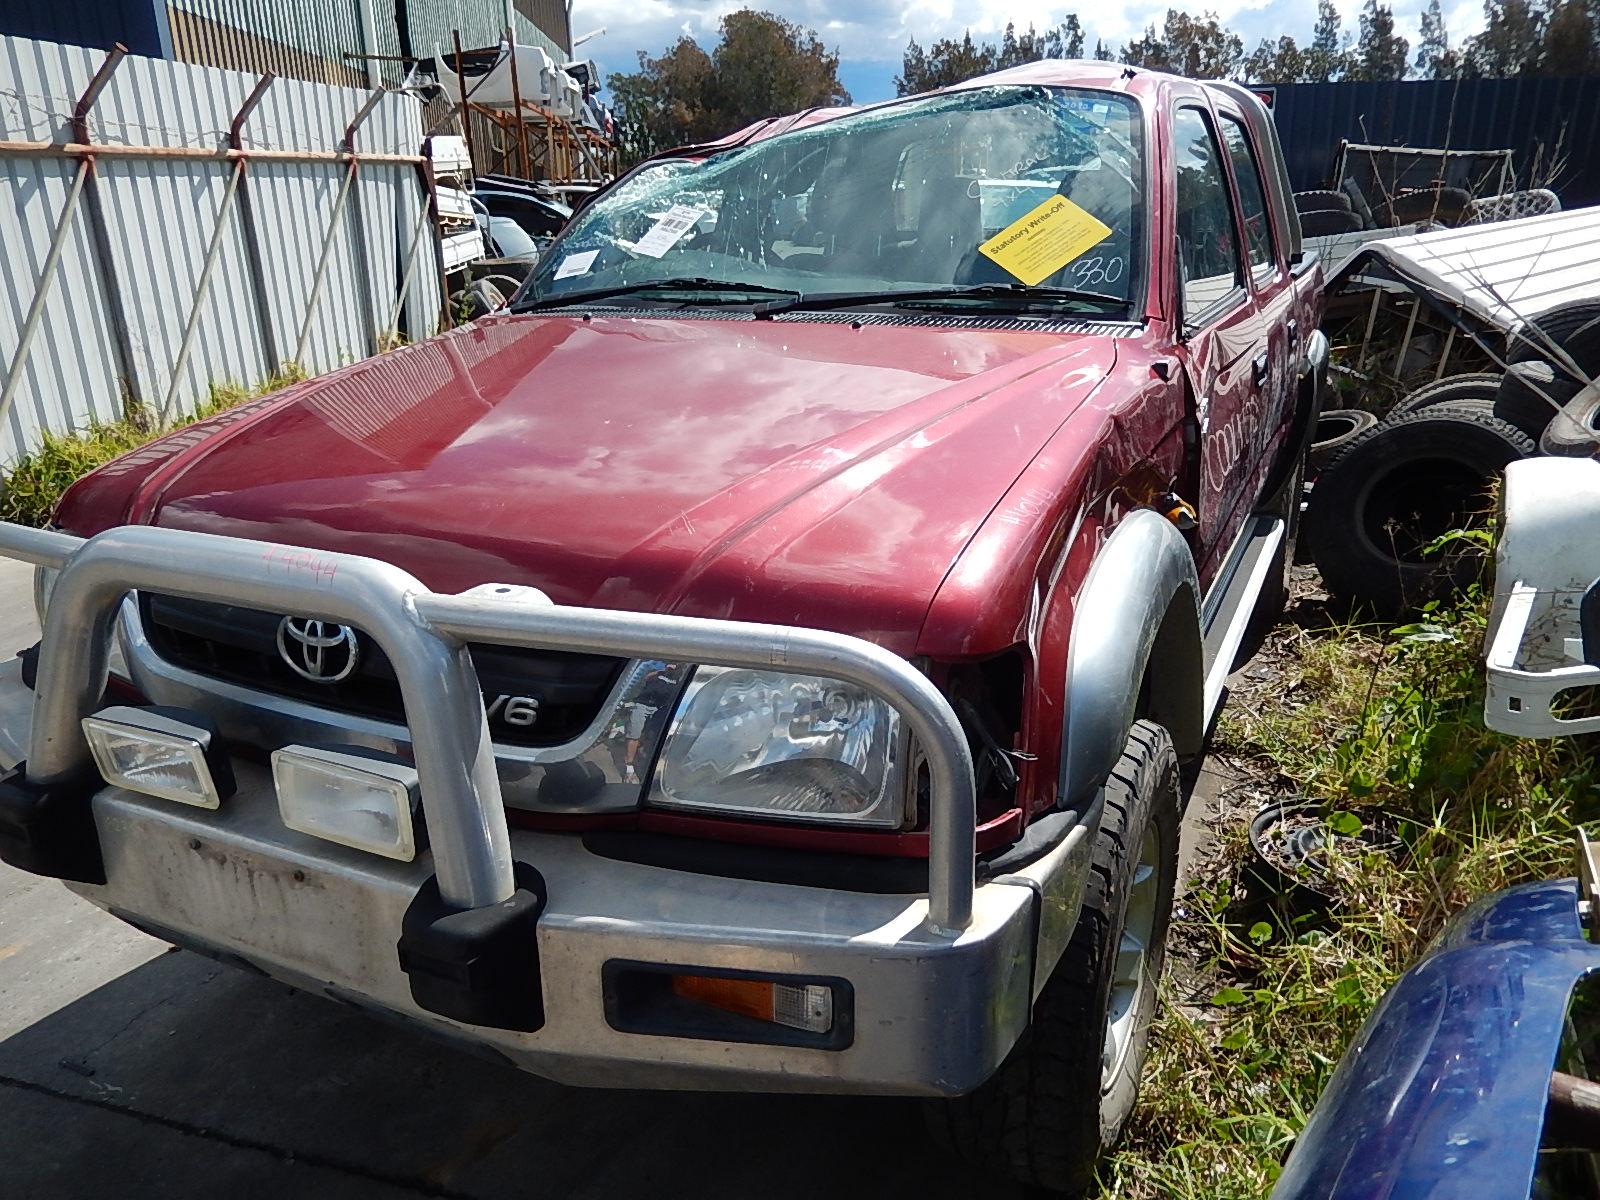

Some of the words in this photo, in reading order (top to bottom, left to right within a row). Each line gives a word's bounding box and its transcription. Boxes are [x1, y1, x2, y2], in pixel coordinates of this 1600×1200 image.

[990, 227, 1030, 255] Statutory
[1027, 202, 1066, 229] Write-Off
[1071, 256, 1123, 289] 330
